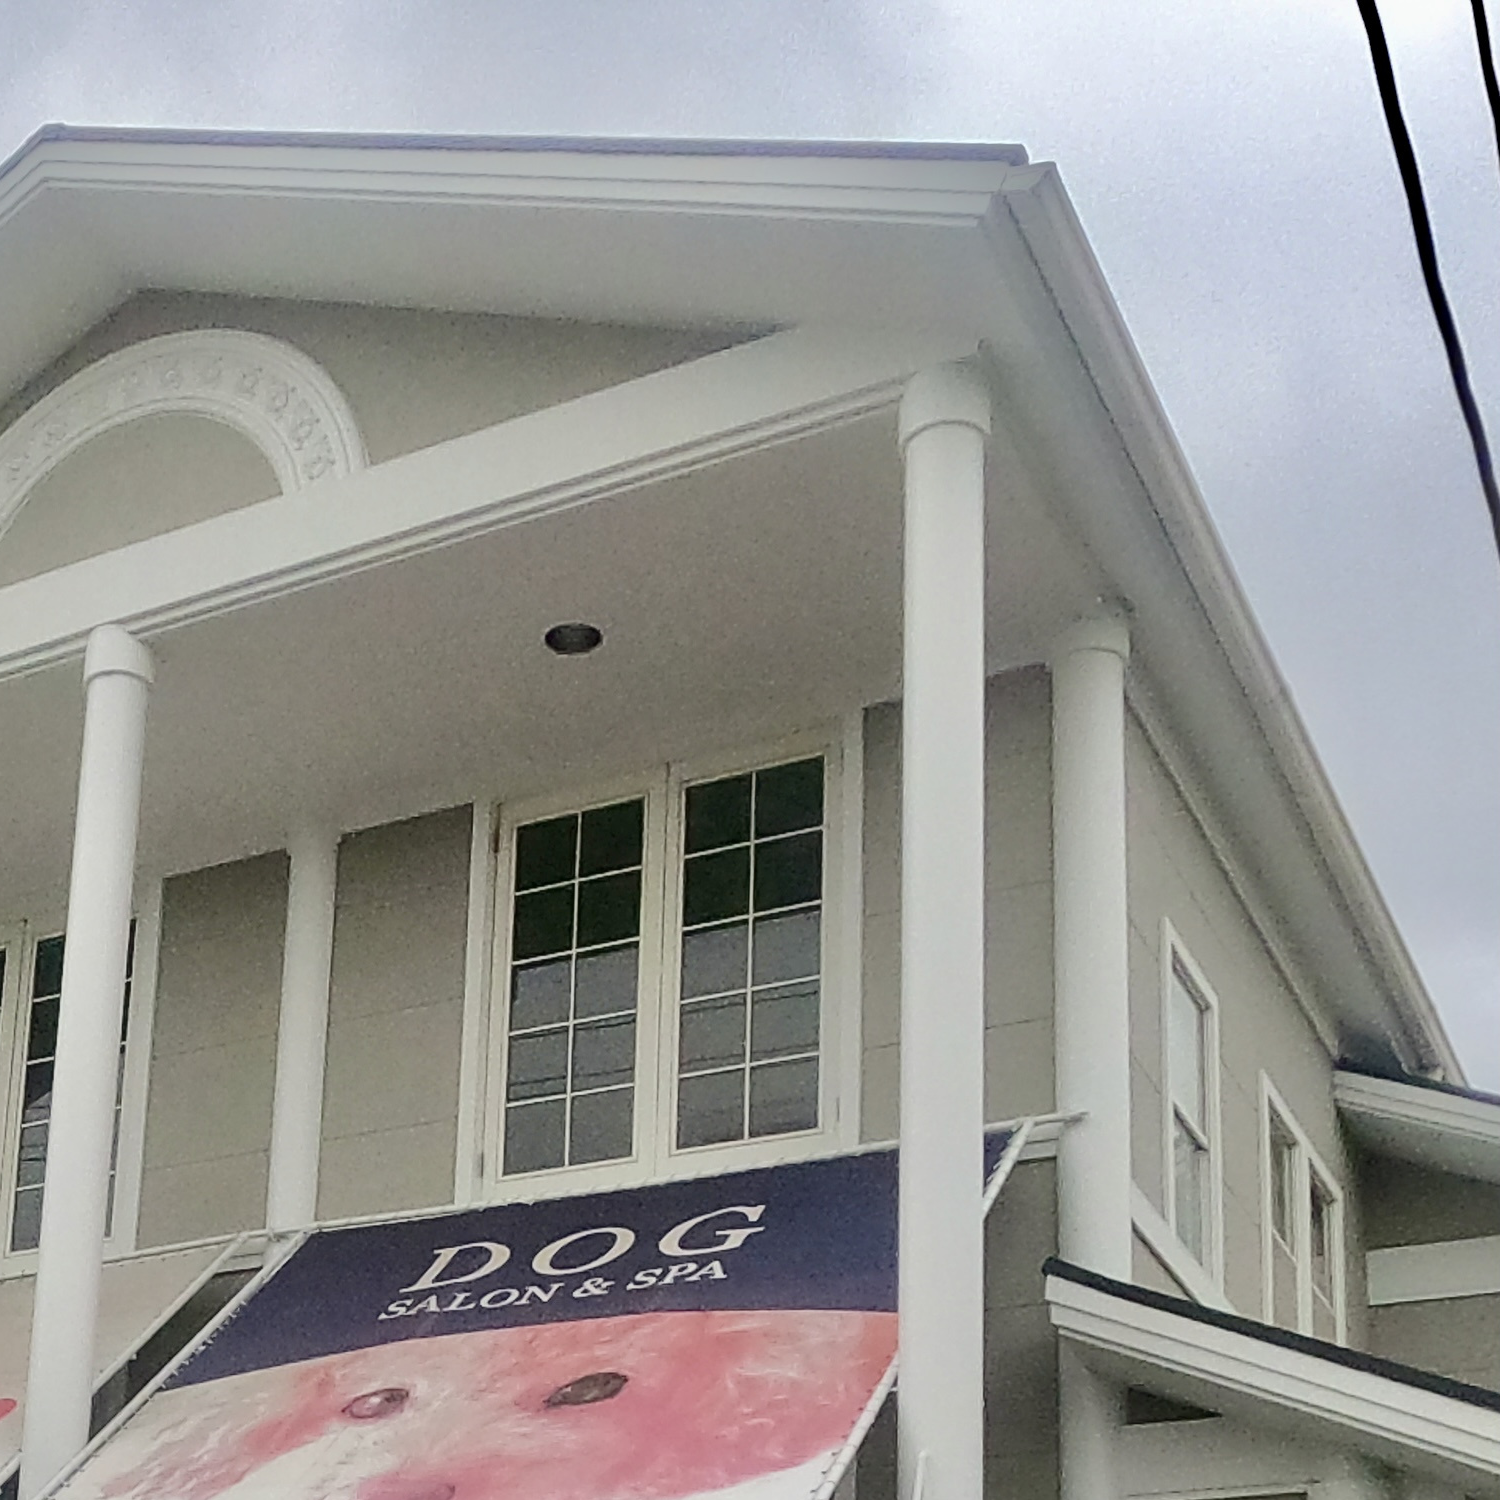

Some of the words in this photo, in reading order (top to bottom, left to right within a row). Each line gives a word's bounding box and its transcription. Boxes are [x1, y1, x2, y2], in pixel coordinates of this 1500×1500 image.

[399, 1204, 766, 1293] DOG
[377, 1282, 564, 1321] SALON
[572, 1277, 615, 1298] &
[626, 1259, 727, 1292] SPA
